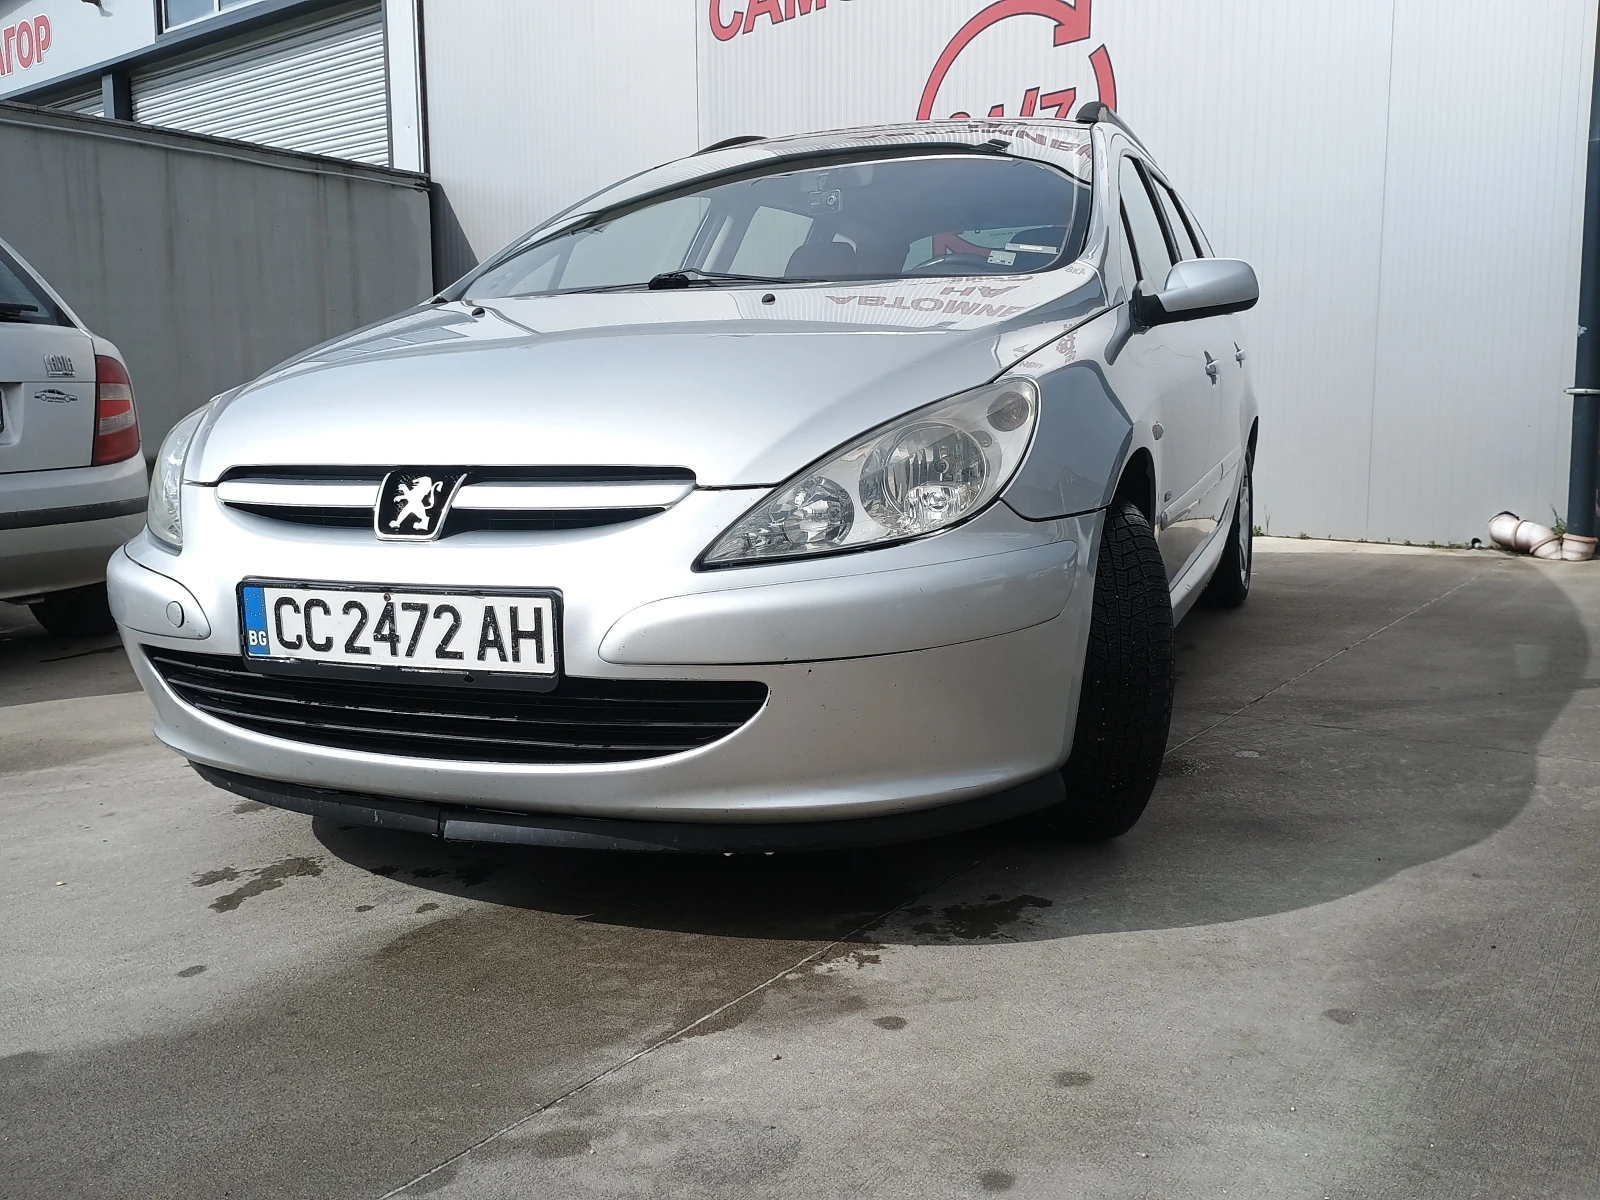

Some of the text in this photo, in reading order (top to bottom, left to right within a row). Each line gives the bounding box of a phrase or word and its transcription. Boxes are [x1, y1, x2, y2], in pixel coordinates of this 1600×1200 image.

[247, 628, 268, 646] BG
[273, 596, 547, 664] CC 2472 AH
